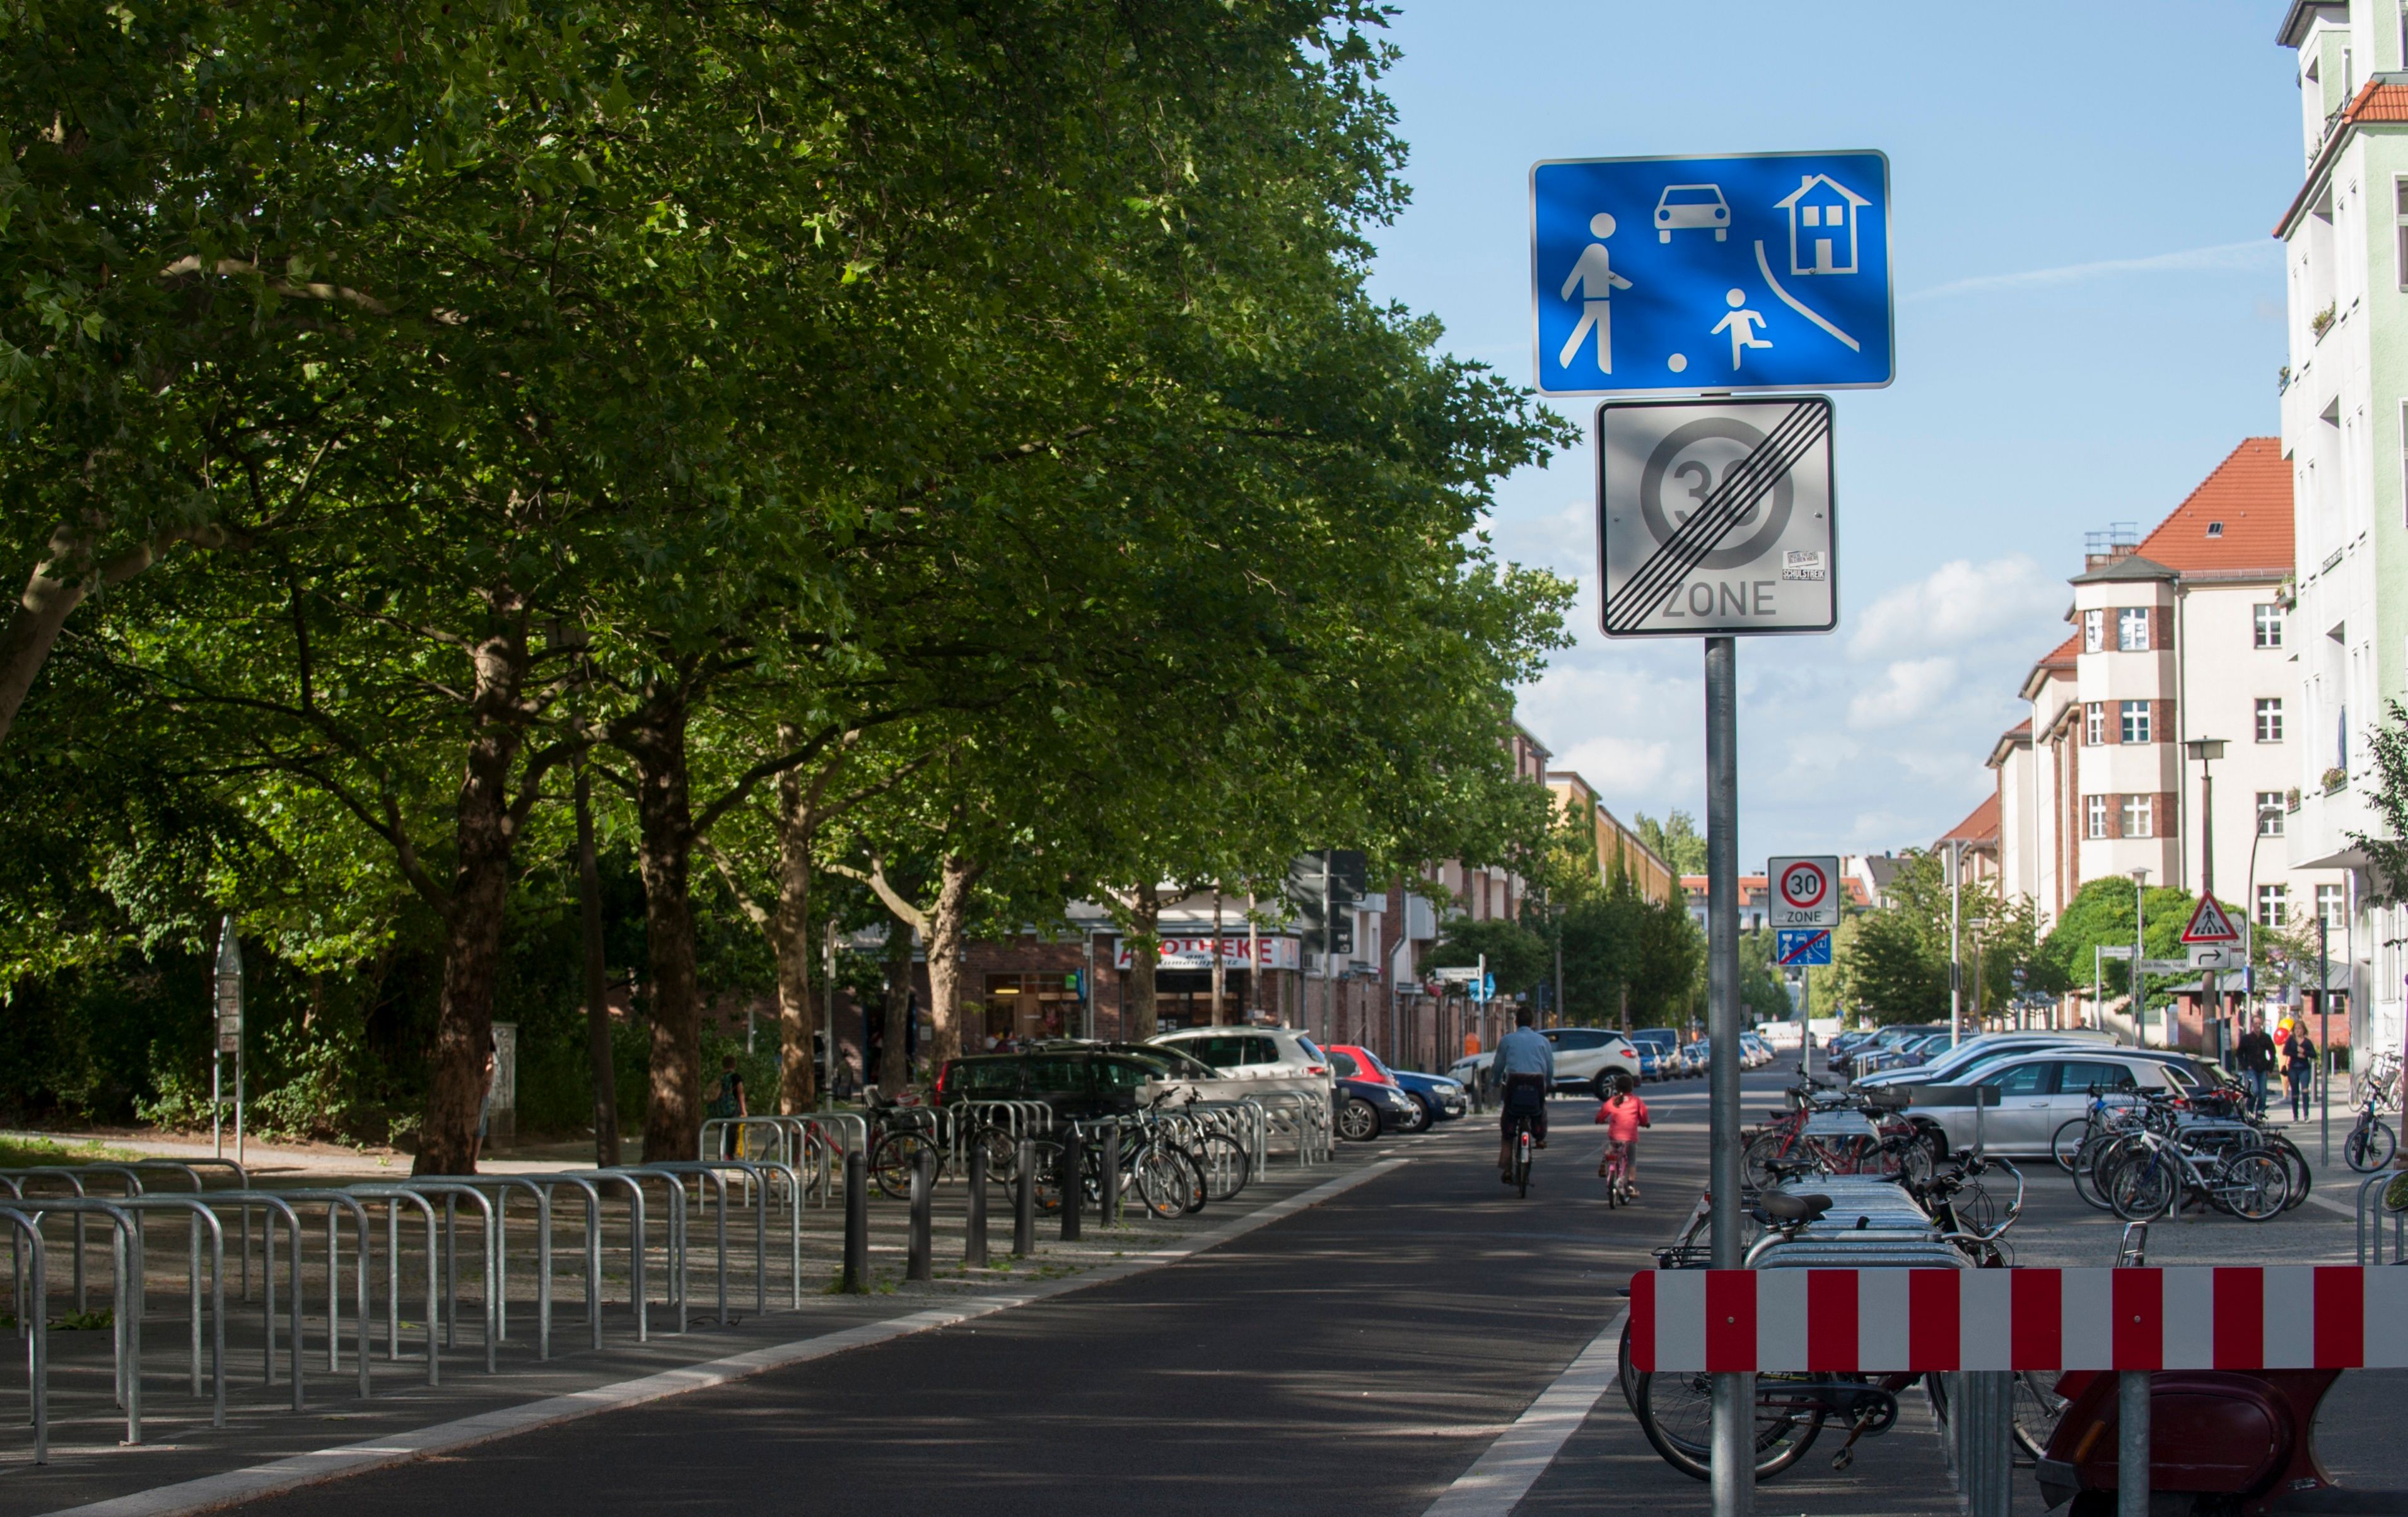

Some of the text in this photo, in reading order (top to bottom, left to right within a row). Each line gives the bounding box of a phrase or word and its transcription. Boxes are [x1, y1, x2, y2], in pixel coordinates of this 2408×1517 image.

[1673, 459, 1760, 527] 30
[1783, 569, 1824, 578] SCHULSTREIK
[1661, 580, 1776, 618] ZONE
[1791, 875, 1817, 895] 30
[1787, 911, 1821, 922] ZONE
[1119, 938, 1273, 965] AOTHEKE
